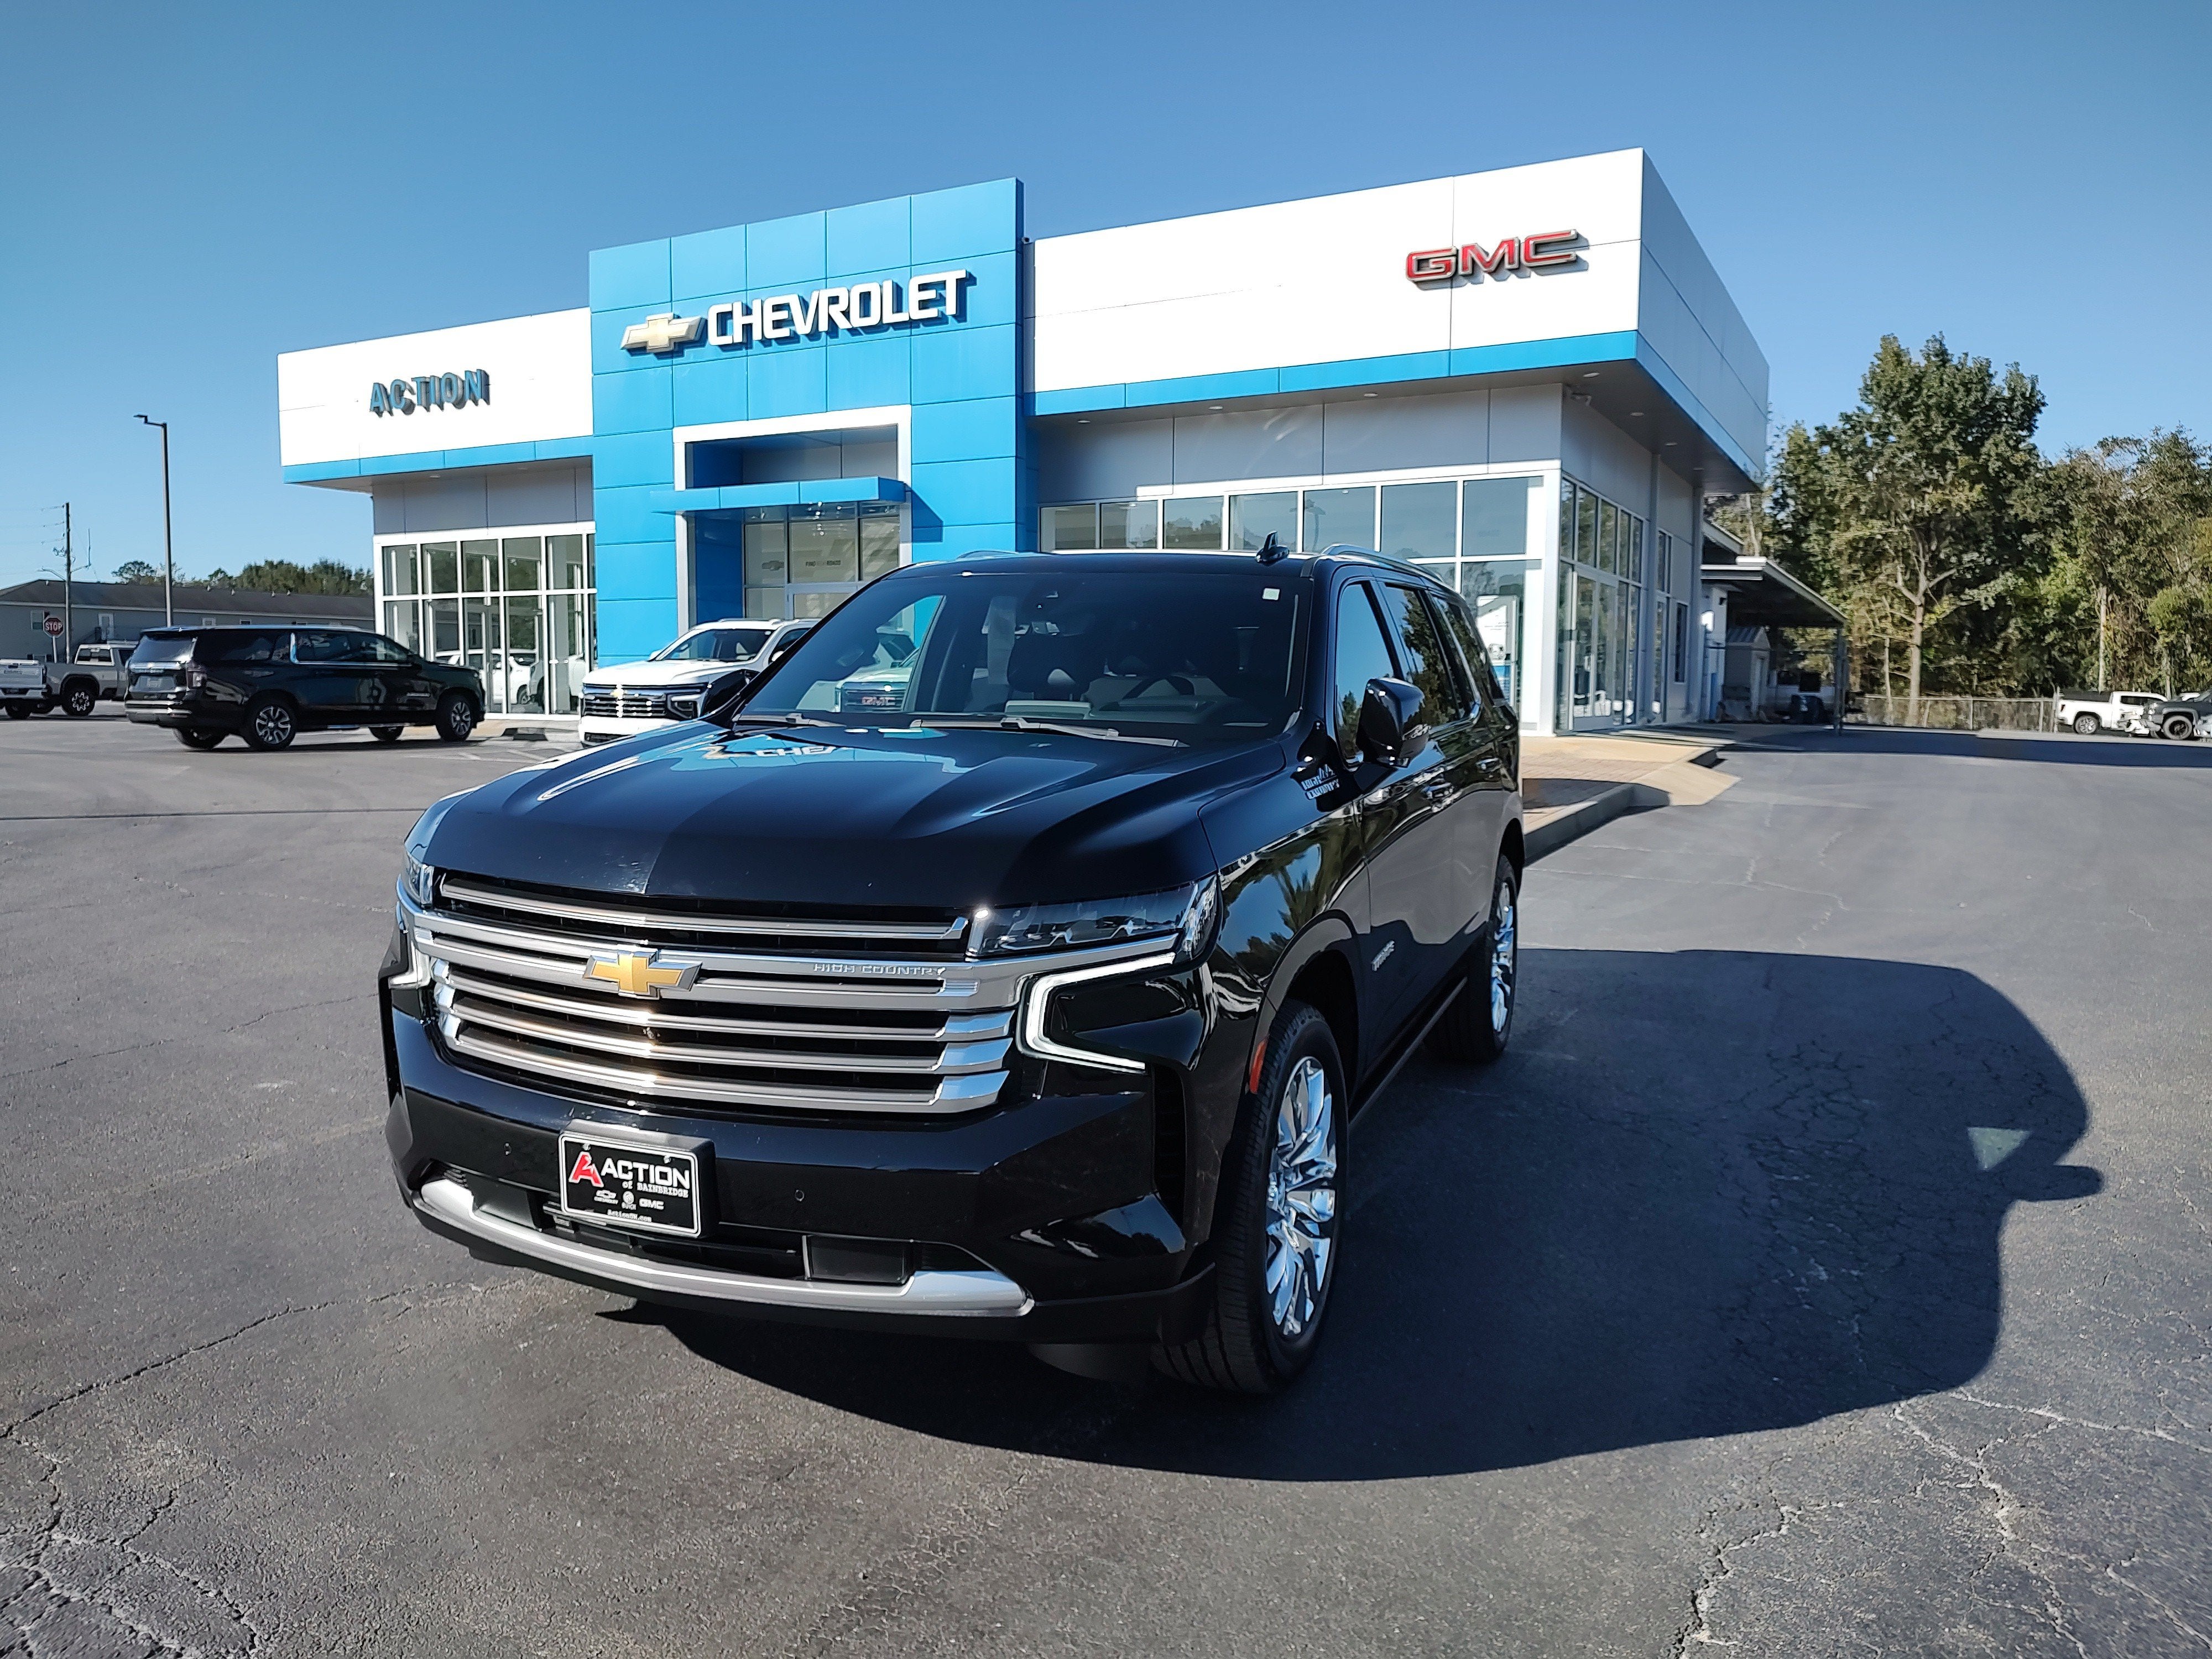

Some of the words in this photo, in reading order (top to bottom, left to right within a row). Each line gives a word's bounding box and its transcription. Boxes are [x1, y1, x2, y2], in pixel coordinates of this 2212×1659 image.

[1405, 228, 1578, 282] GMC
[707, 269, 968, 346] CHEVROLET
[369, 368, 490, 416] ACTION
[45, 621, 62, 631] STOP
[813, 963, 855, 973] HIGH
[860, 965, 946, 975] COUNTRY
[601, 1157, 691, 1190] ACTION
[622, 1180, 633, 1190] of
[637, 1182, 689, 1198] BAINBRIDGE
[639, 1198, 664, 1211] GMC
